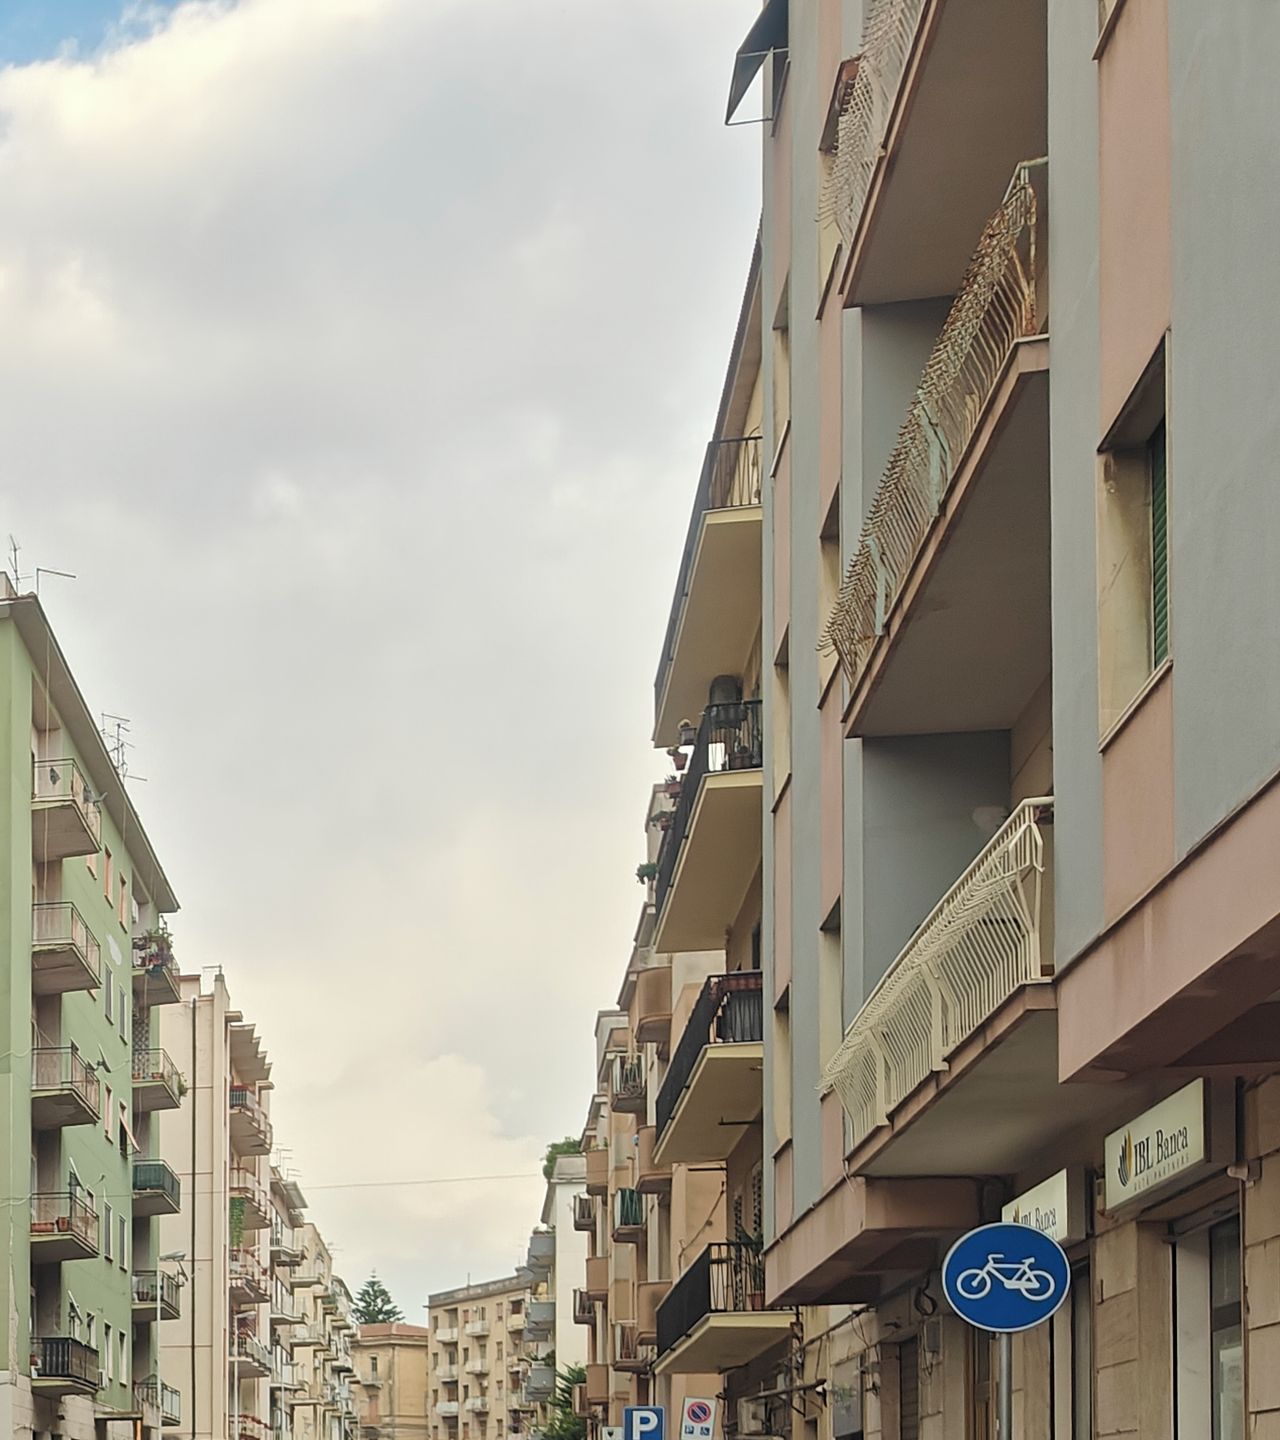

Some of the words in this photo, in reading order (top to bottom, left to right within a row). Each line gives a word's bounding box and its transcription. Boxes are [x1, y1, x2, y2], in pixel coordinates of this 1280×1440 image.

[1134, 1136, 1153, 1177] IBL
[1156, 1126, 1188, 1164] Banca
[632, 1410, 658, 1440] P
